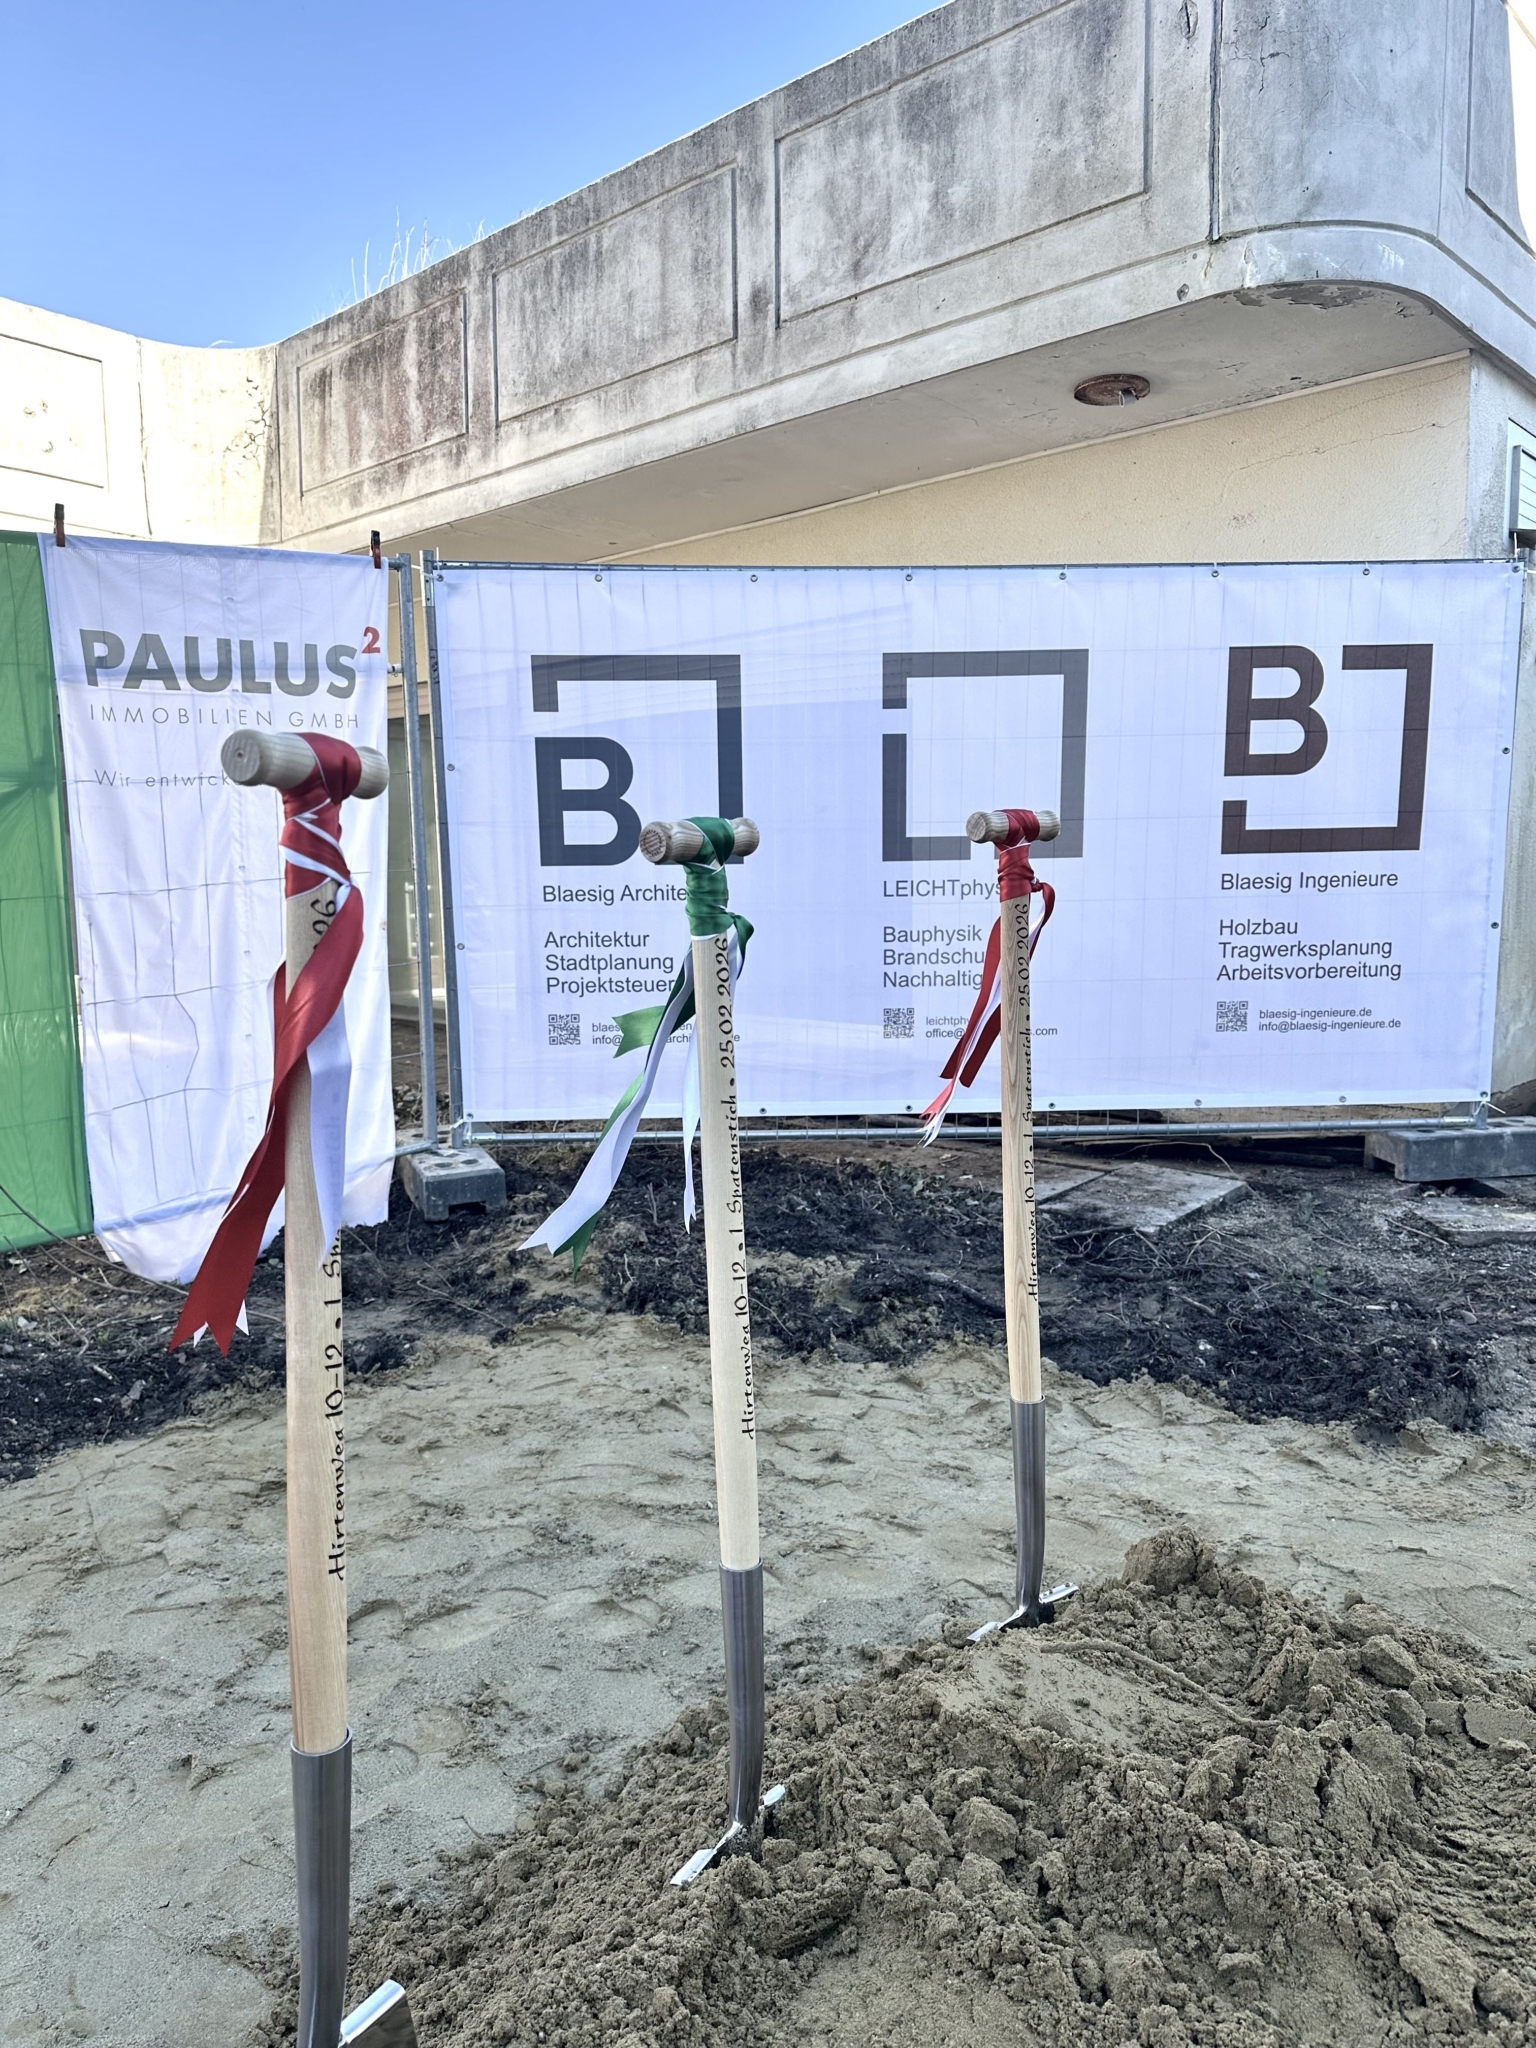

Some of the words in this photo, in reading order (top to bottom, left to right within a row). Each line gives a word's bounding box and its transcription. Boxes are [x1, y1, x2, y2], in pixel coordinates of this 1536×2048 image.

[90, 704, 272, 727] IMMOBILIEN
[288, 711, 359, 728] GMBH
[94, 769, 130, 787] Wir
[145, 769, 231, 788] entwick
[883, 879, 1001, 900] LEICHTphys
[1220, 872, 1292, 893] Blaesig
[1299, 870, 1399, 893] Ingenieure
[543, 884, 615, 906] Blaesig
[619, 884, 687, 902] Archite
[883, 924, 983, 947] Bauphysik
[1219, 918, 1298, 936] Holzbau
[544, 930, 650, 948] Architektur
[883, 947, 985, 966] Brandschu
[1218, 940, 1393, 962] Tragwerksplanung
[545, 953, 674, 975] Stadtplanung
[1216, 961, 1402, 981] Arbeitsvorbereitung
[546, 976, 675, 998] Projektsteuer
[883, 970, 983, 991] Nachhaltig
[715, 937, 735, 1069] 25.02.2026
[1259, 1007, 1373, 1020] blaesig-ingenieure.de
[1258, 1019, 1401, 1033] info@blaesig-ingenieure.de
[731, 1259, 748, 1319] 10-12
[324, 1340, 344, 1421] 10-12
